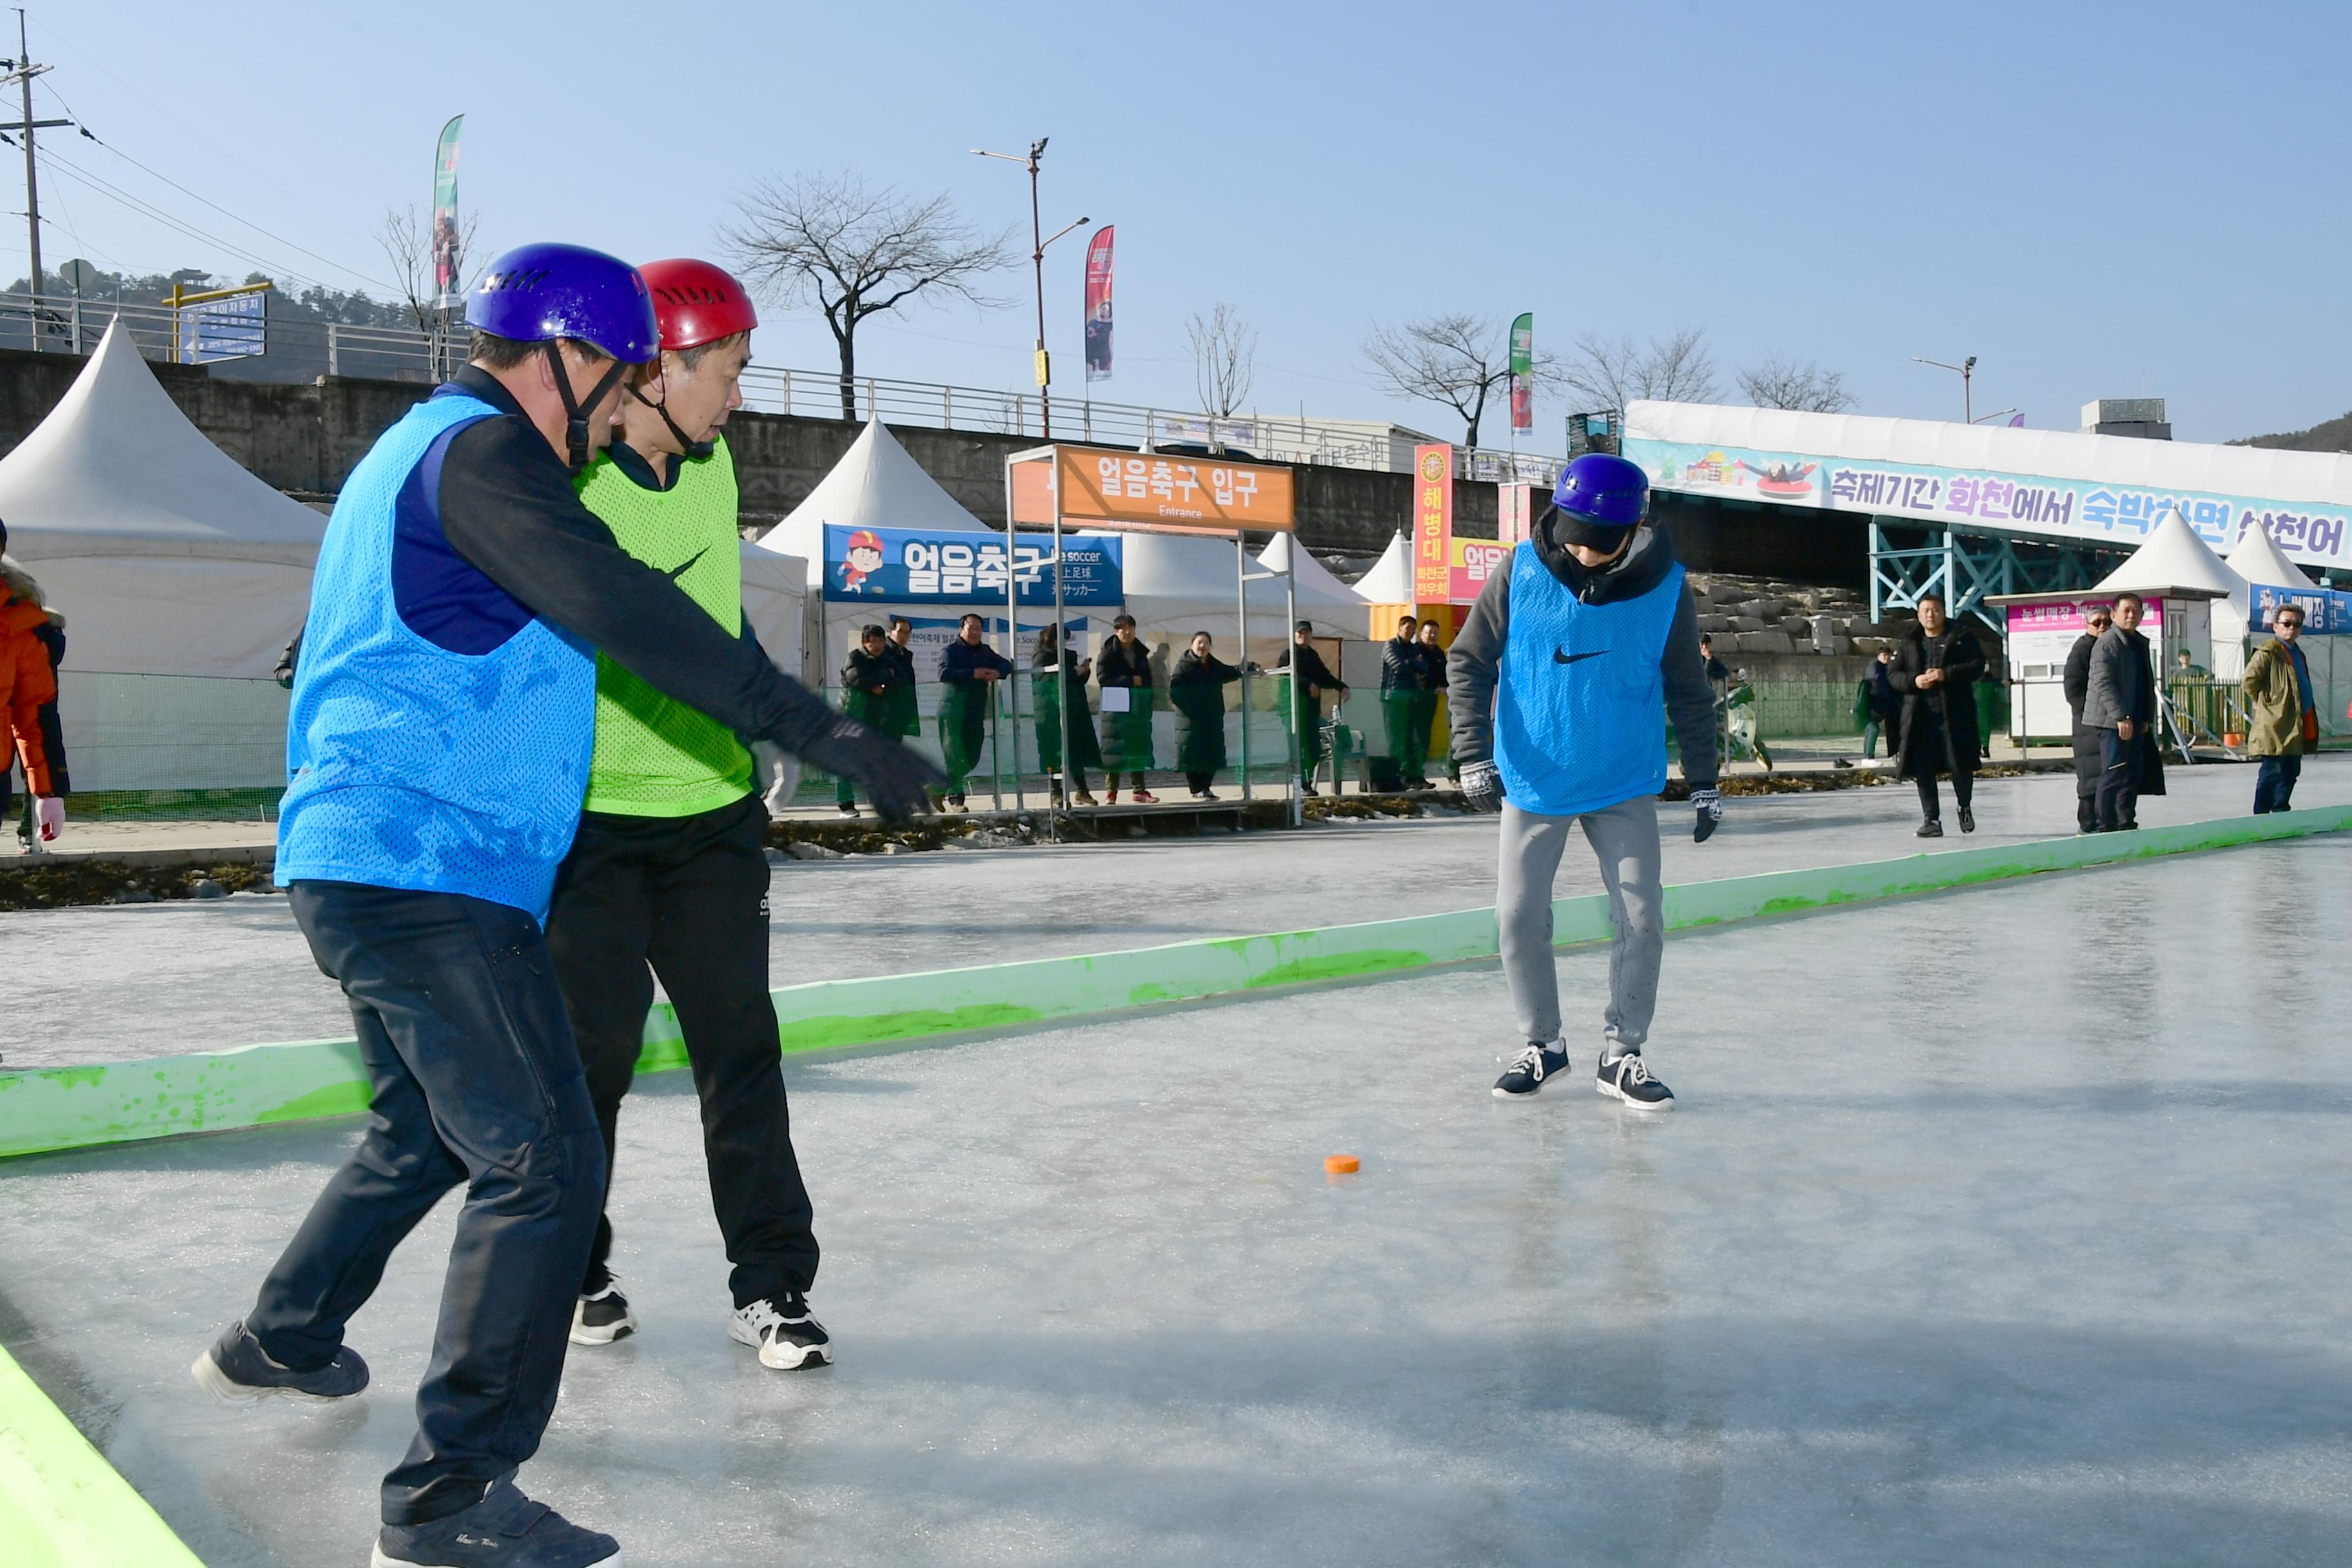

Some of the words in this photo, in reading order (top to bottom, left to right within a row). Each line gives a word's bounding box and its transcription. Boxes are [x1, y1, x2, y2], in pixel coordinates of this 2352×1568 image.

[1099, 456, 1199, 502] 얼음축구
[1212, 467, 1258, 507] 입구
[1832, 469, 1940, 511] 축제기간
[1945, 477, 2073, 525] 화천에서
[1159, 505, 1202, 519] Entrance
[1423, 486, 1442, 561] 해병대
[1050, 547, 1066, 562] Ie
[1067, 551, 1101, 563] soccer
[904, 542, 1042, 596] 얼음축구
[1416, 565, 1447, 580] 화천군
[1416, 582, 1447, 596] 전우회
[2021, 606, 2072, 622] 눈썰매장
